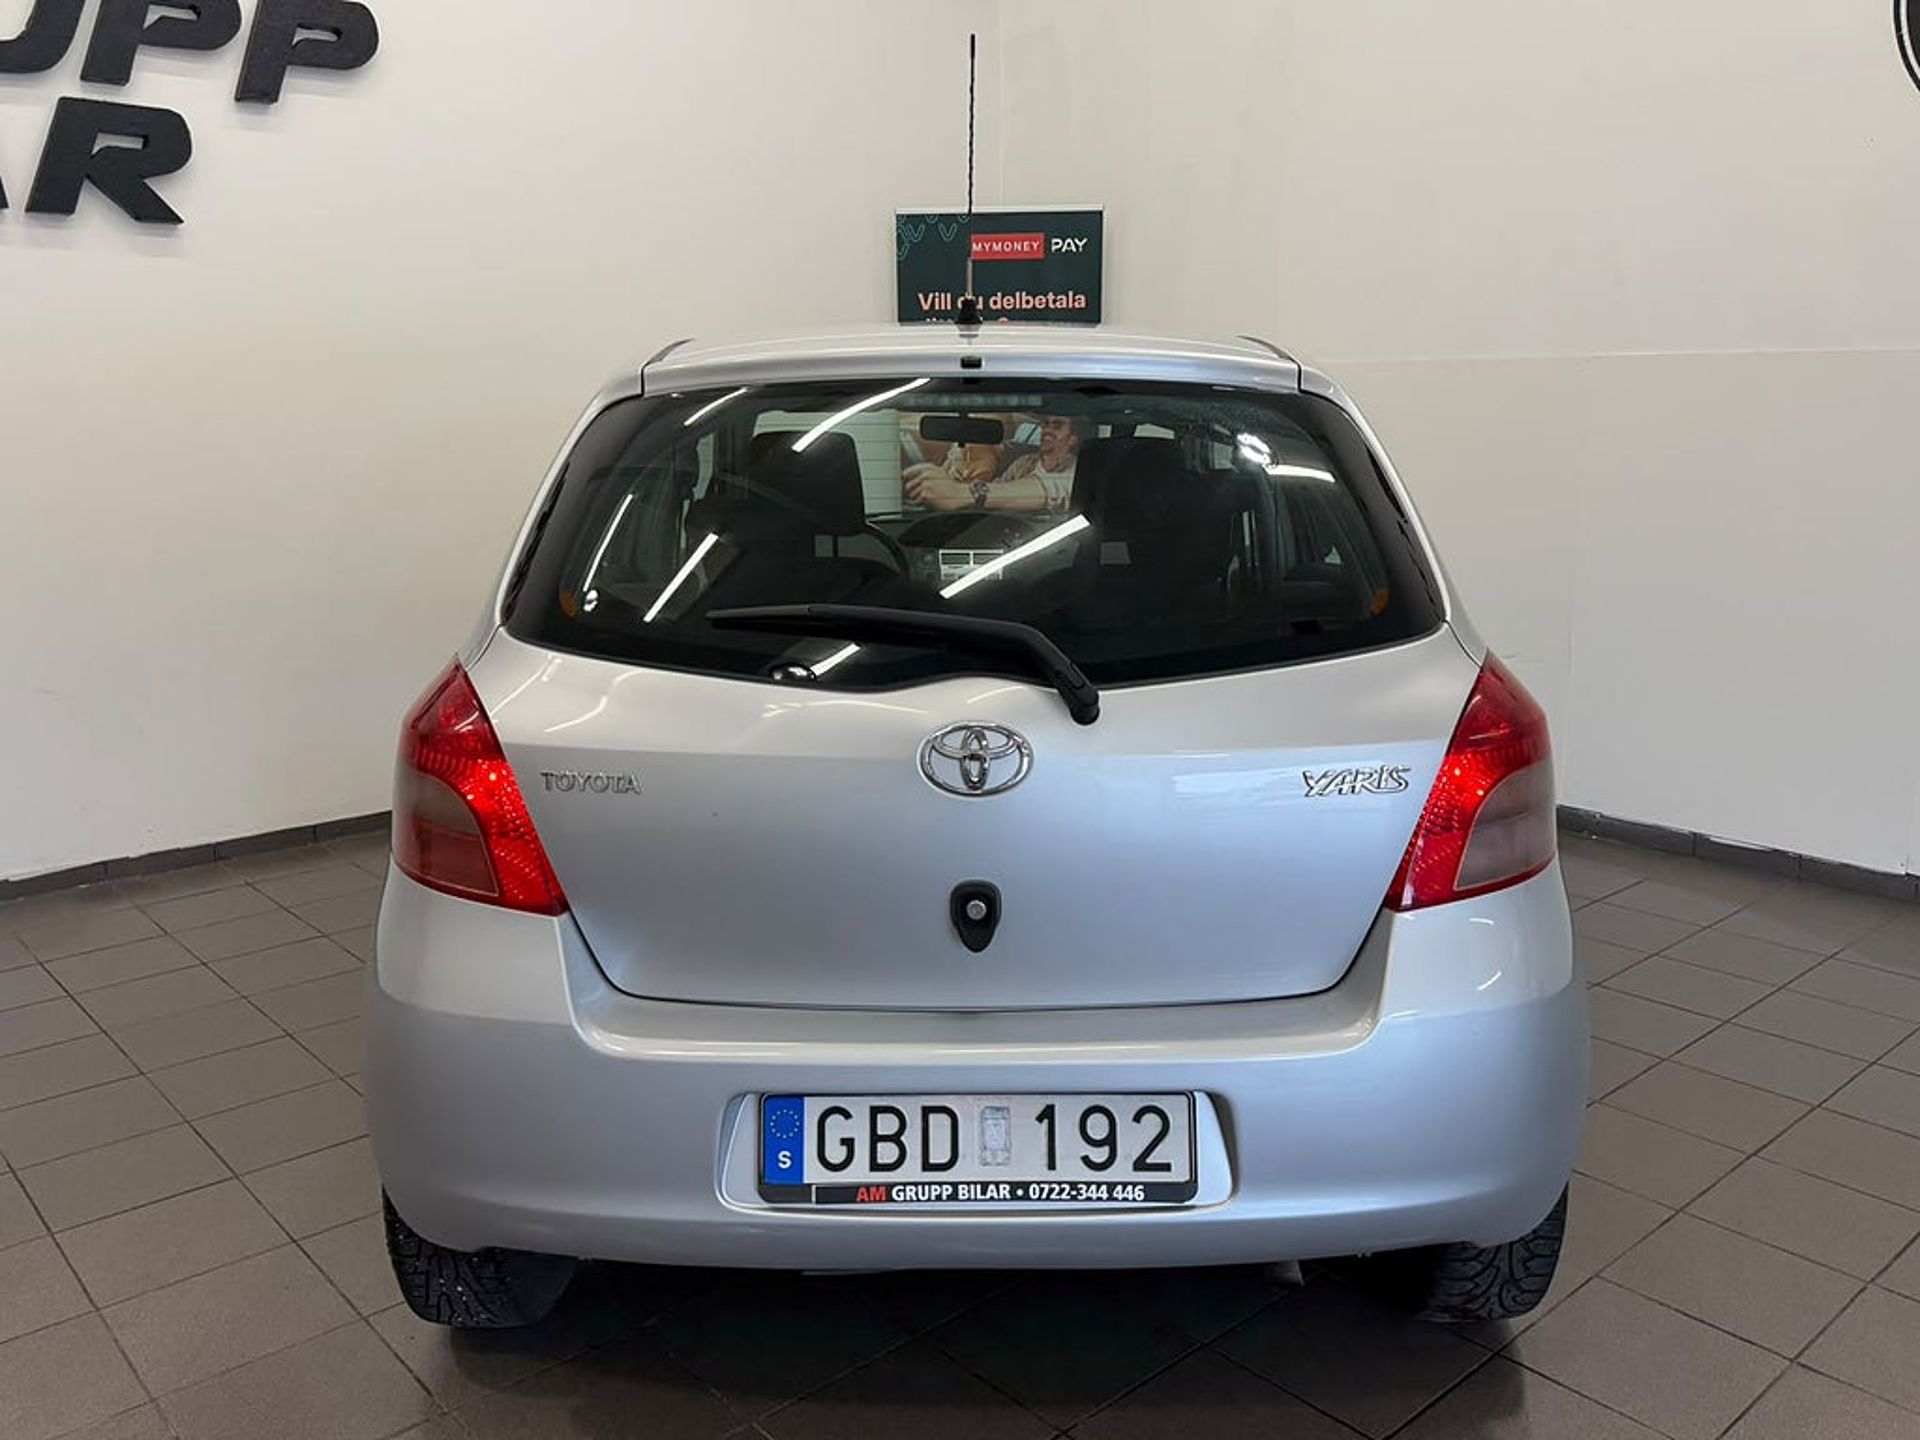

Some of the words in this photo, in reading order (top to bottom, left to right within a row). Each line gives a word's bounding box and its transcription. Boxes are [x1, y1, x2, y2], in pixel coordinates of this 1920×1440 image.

[0, 96, 193, 225] R
[972, 240, 1040, 252] MYMONEY
[1051, 238, 1088, 253] PAY
[918, 292, 952, 311] Vill
[989, 291, 1086, 310] delbetala
[541, 771, 642, 795] TOYOTA
[1302, 764, 1411, 798] YARIS
[816, 1105, 958, 1173] GBD
[1035, 1103, 1172, 1172] 192
[777, 1149, 792, 1169] S
[856, 1186, 887, 1202] AM
[891, 1185, 952, 1201] GRUPP
[957, 1184, 1011, 1200] BILAR
[1028, 1183, 1109, 1200] 0722-344
[1112, 1185, 1145, 1201] 446
